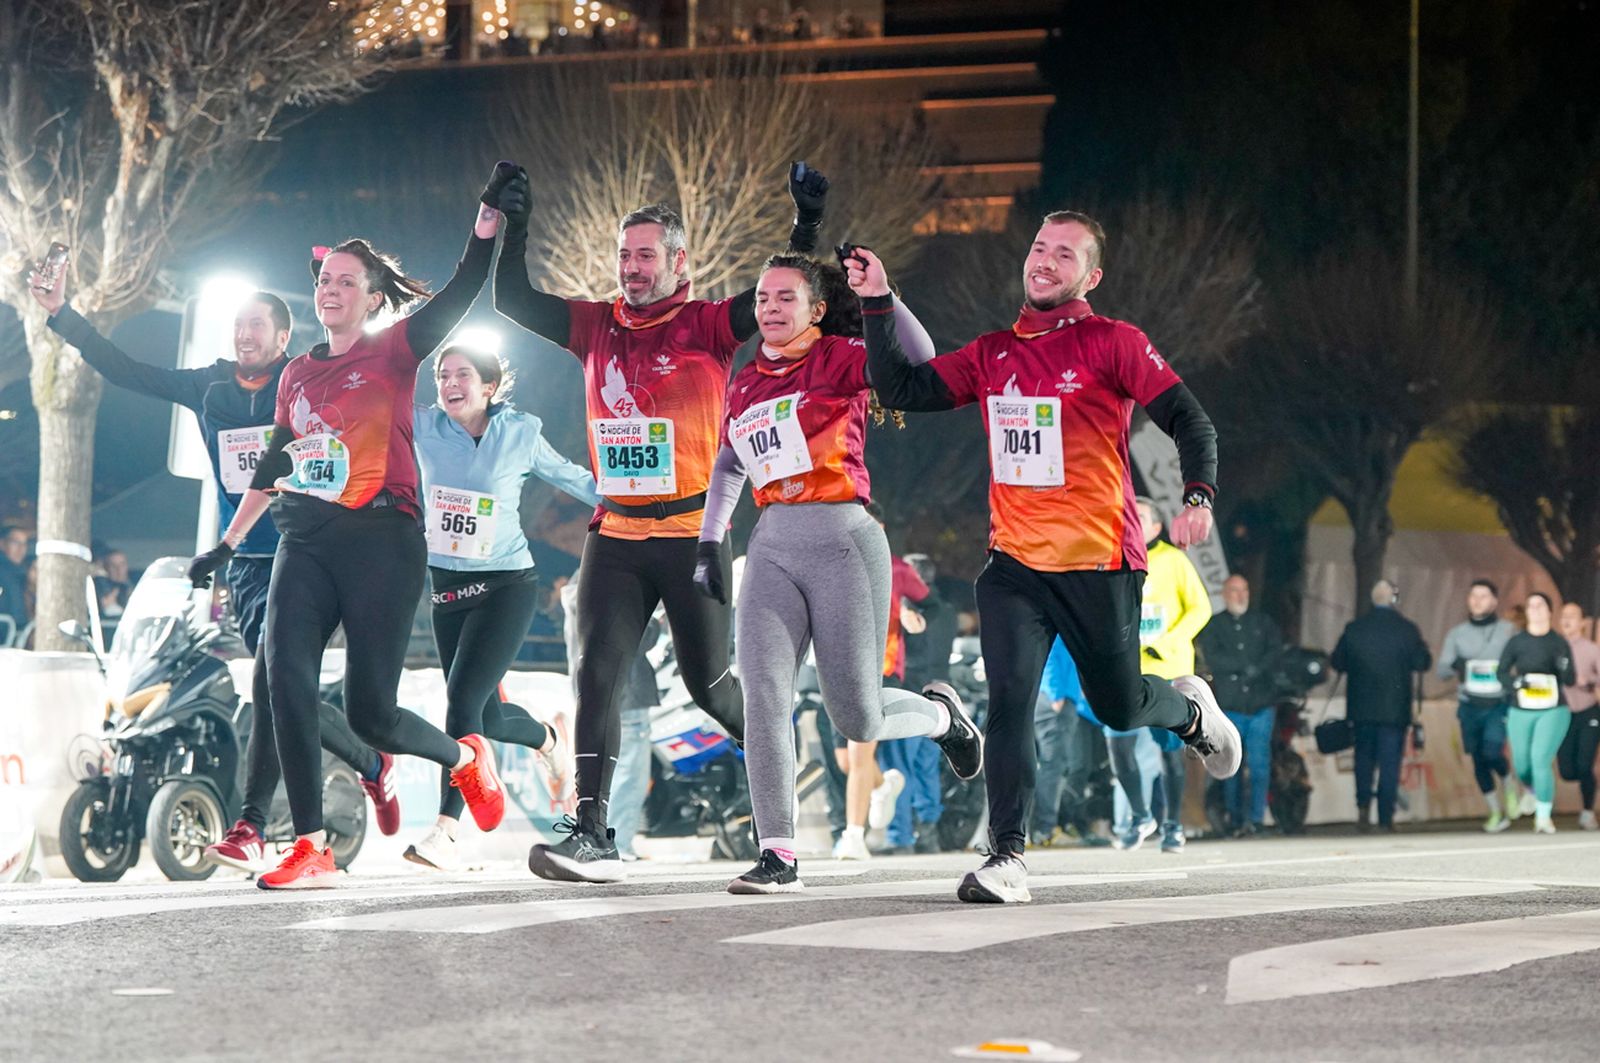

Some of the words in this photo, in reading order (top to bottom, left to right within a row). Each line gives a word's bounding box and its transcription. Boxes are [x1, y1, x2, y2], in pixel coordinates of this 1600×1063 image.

[612, 397, 634, 418] 43
[742, 411, 760, 424] NOCHE
[761, 408, 769, 416] DE
[607, 426, 630, 435] NOCHE
[631, 426, 641, 434] DE
[735, 428, 747, 439] SAN
[601, 436, 614, 445] SAN
[748, 426, 781, 457] 104
[1003, 428, 1041, 455] 7041
[607, 445, 659, 469] 8453
[435, 501, 447, 510] SAN
[443, 495, 462, 504] NOCHE
[441, 511, 477, 536] 565
[457, 583, 487, 599] MAX
